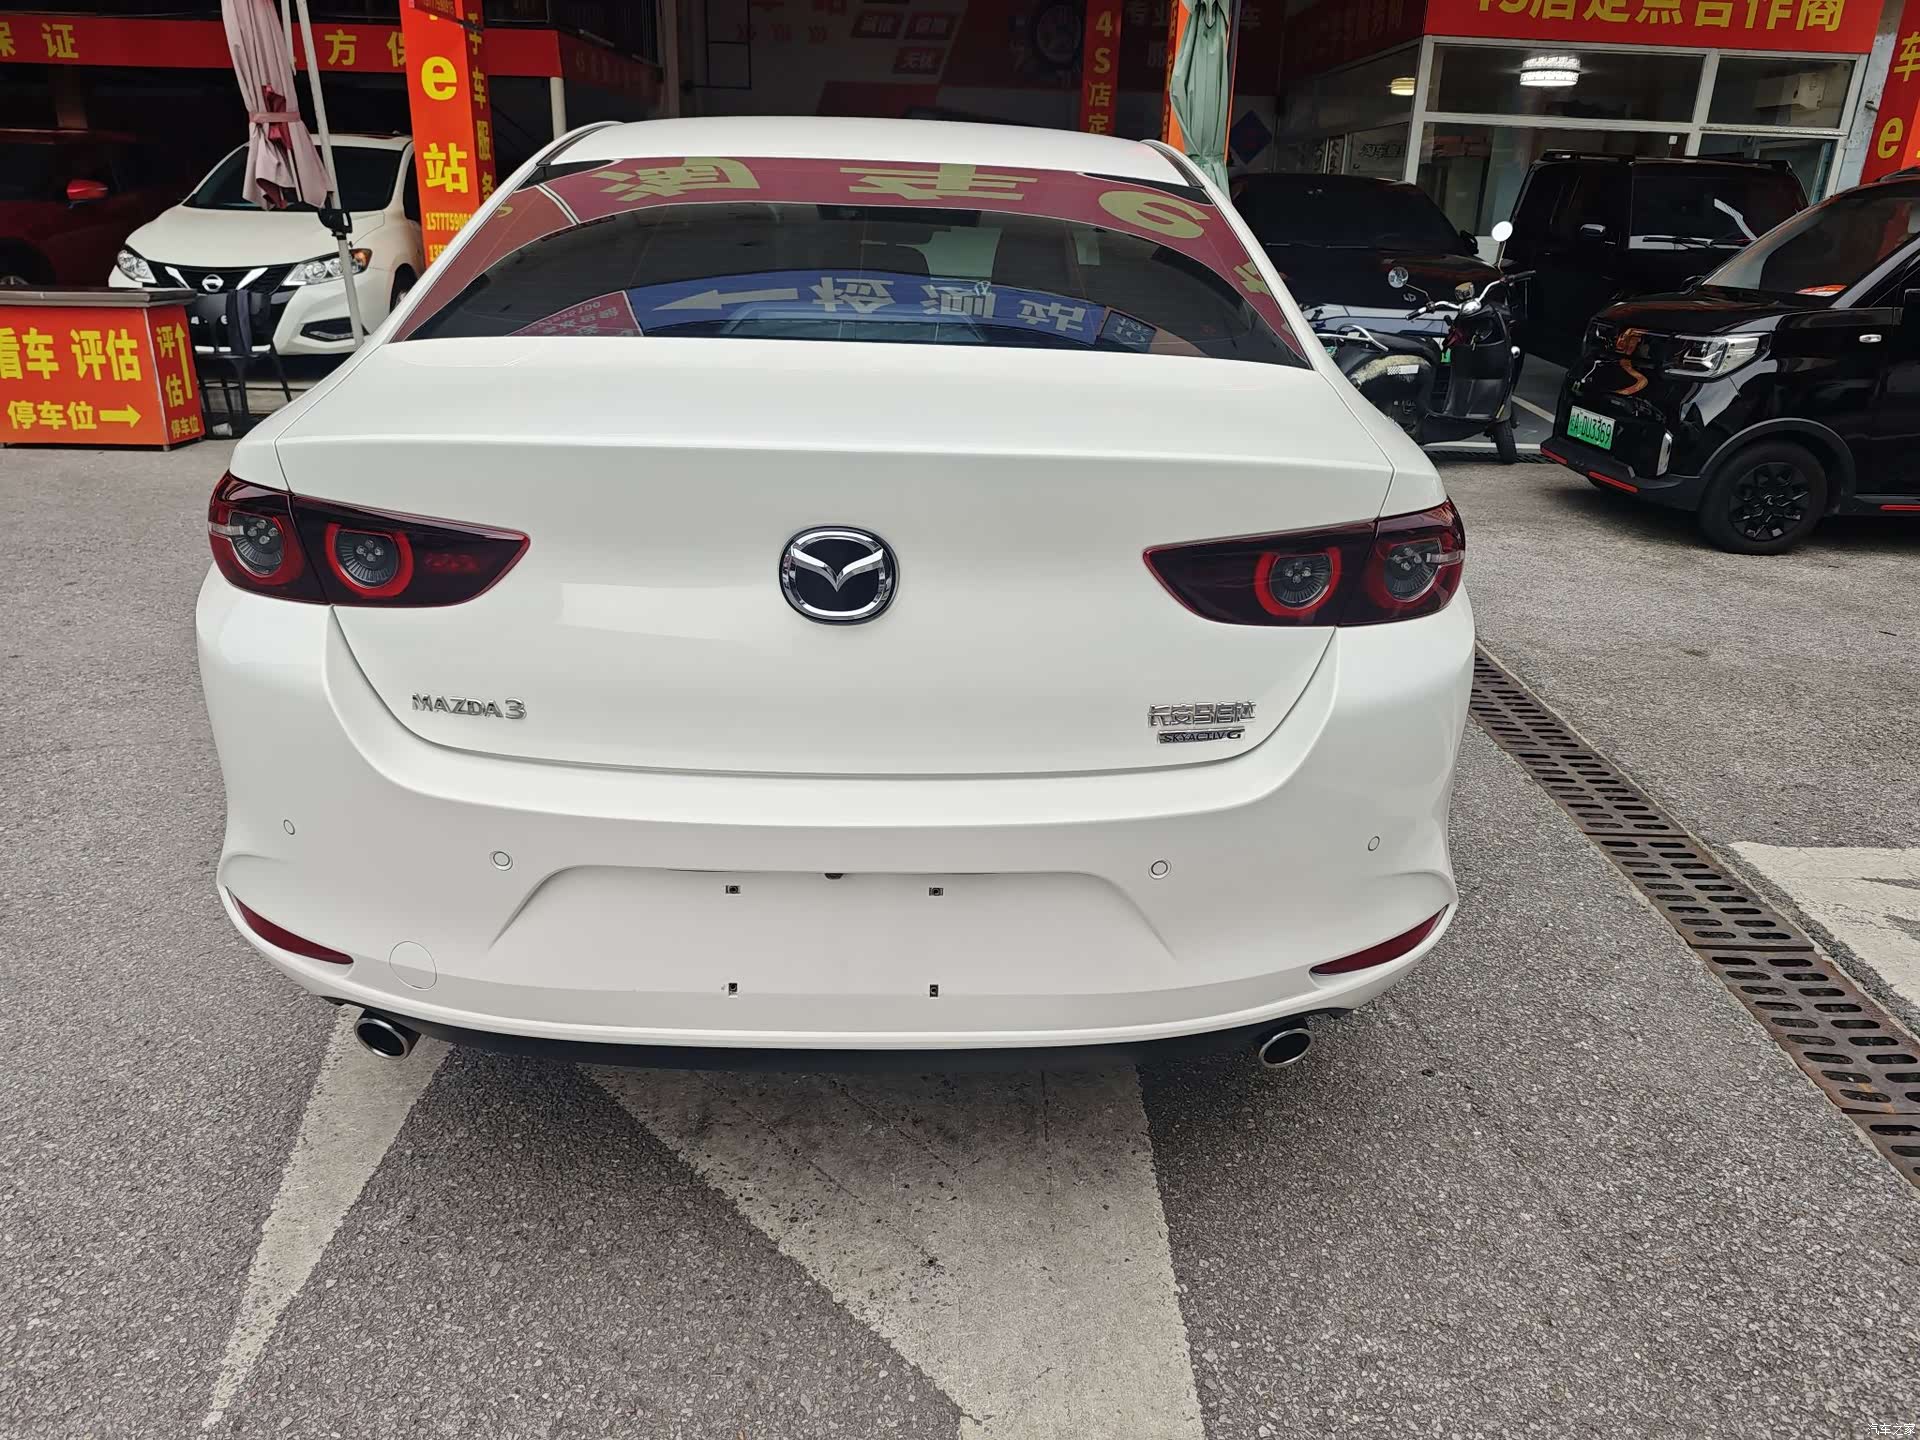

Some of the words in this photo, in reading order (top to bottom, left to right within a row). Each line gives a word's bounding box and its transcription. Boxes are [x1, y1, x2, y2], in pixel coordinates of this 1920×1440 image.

[70, 328, 142, 381] 评估
[156, 325, 184, 408] 评估
[7, 400, 97, 431] 停车位
[171, 414, 200, 439] 停车位
